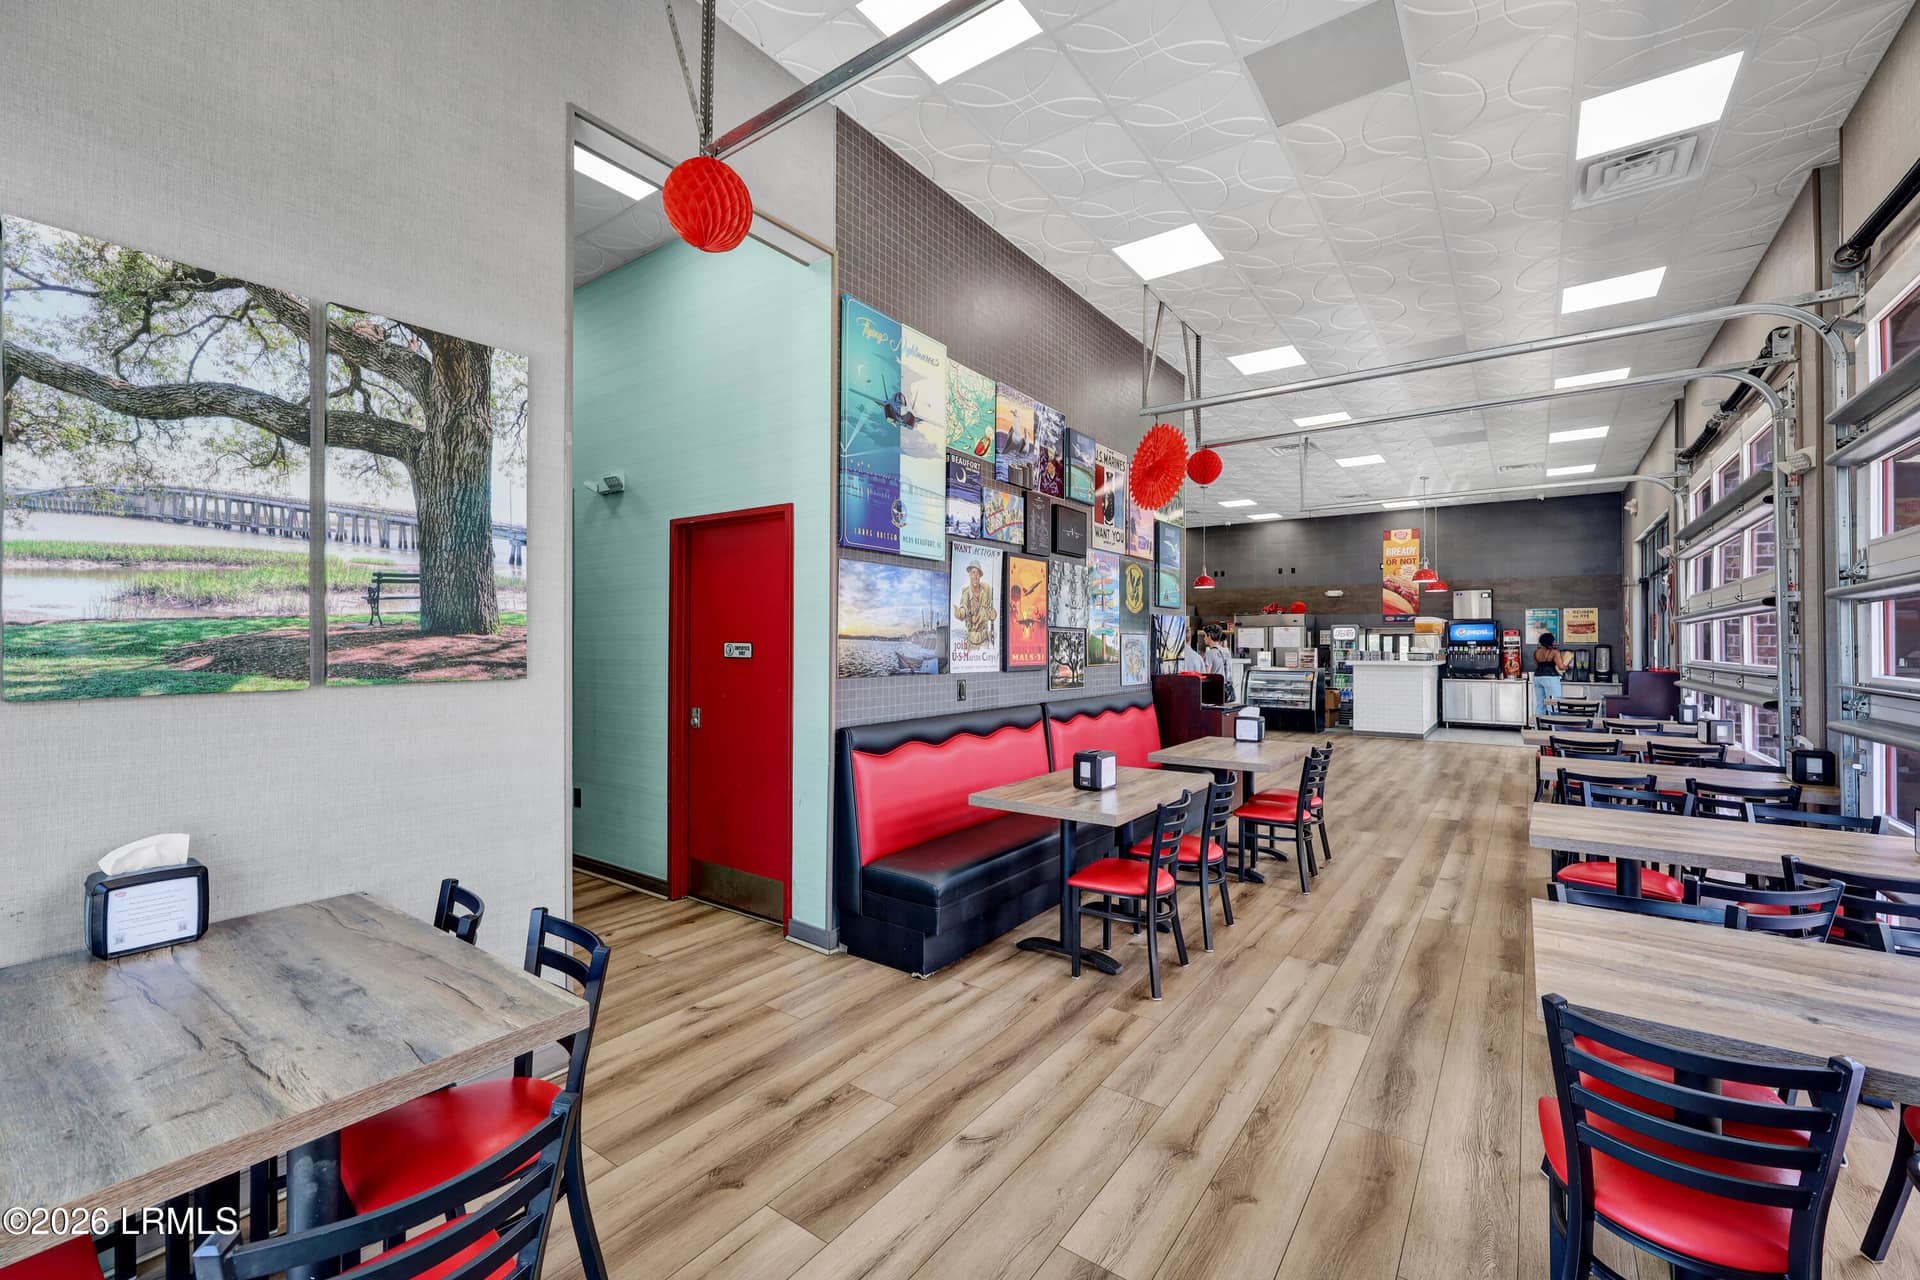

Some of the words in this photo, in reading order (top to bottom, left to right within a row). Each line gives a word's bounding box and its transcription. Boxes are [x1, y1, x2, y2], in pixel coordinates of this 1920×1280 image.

[951, 454, 981, 470] BEAUFORT
[1095, 527, 1110, 539] WANT
[1112, 529, 1124, 544] YOU
[954, 543, 972, 554] WANT
[1386, 546, 1417, 557] BREADY
[1386, 558, 1397, 566] OR
